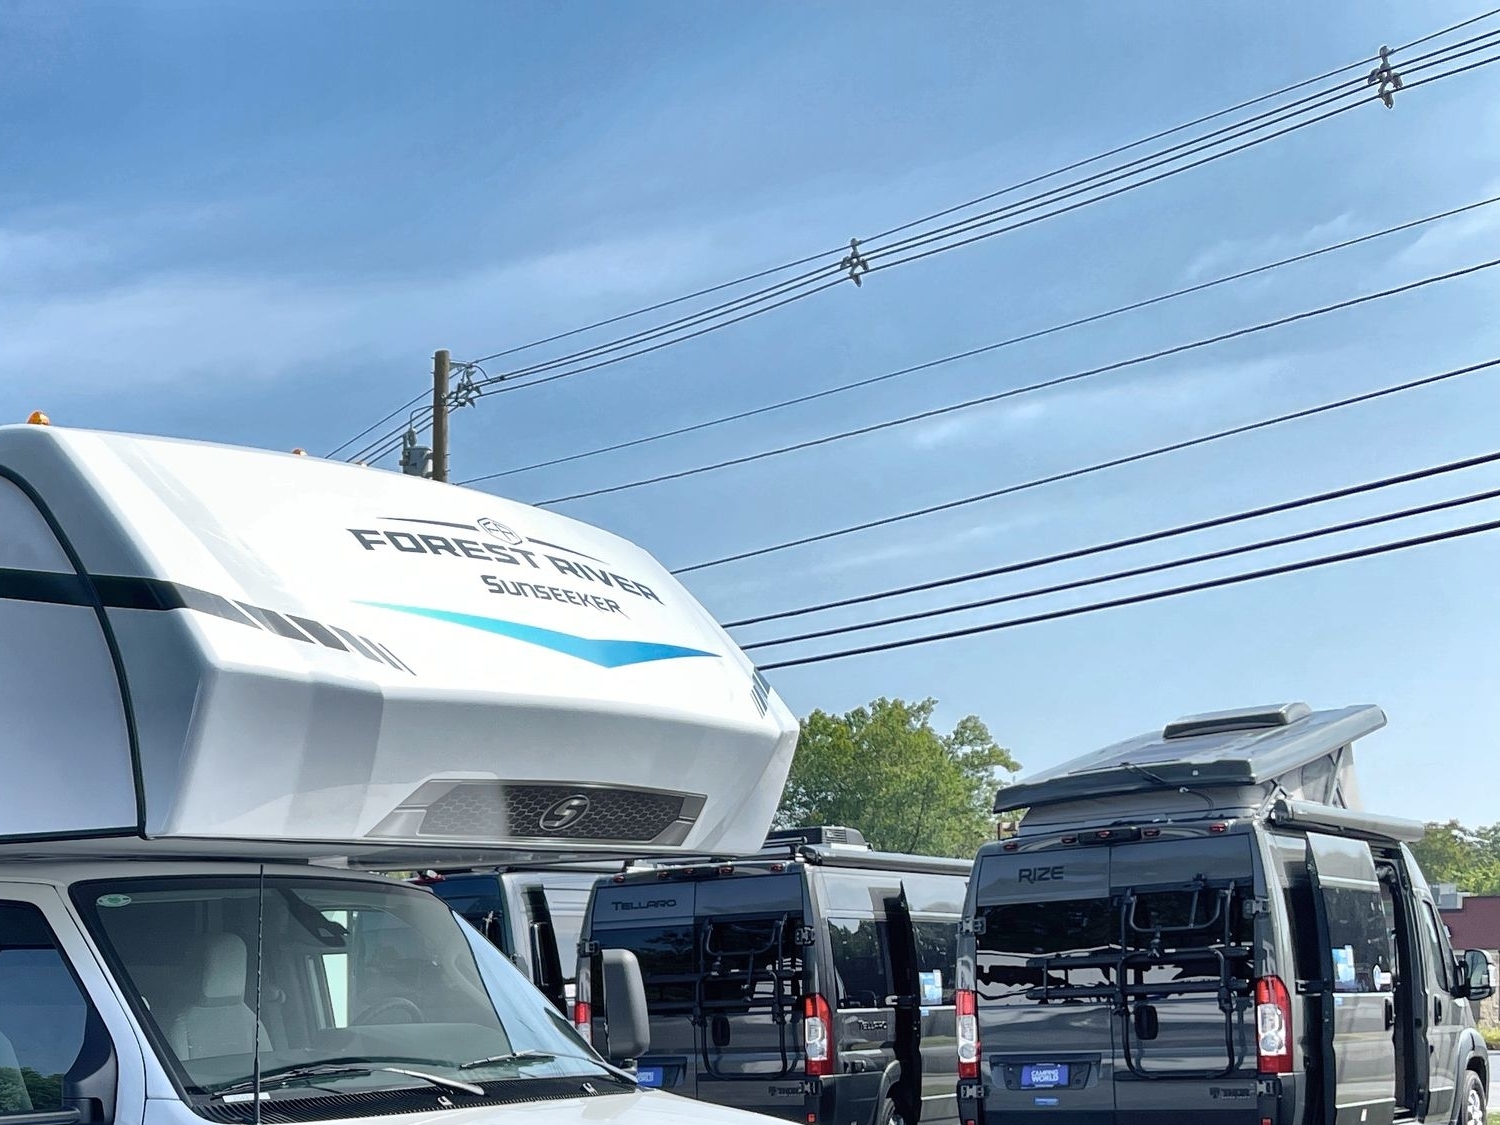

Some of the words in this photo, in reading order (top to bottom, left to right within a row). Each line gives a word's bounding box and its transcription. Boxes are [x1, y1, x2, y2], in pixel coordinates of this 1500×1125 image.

[345, 527, 541, 570] FOREST
[542, 553, 667, 607] RIVER
[1018, 866, 1065, 885] RIZE
[611, 899, 677, 912] TELLARO
[1031, 1073, 1059, 1082] WORLD
